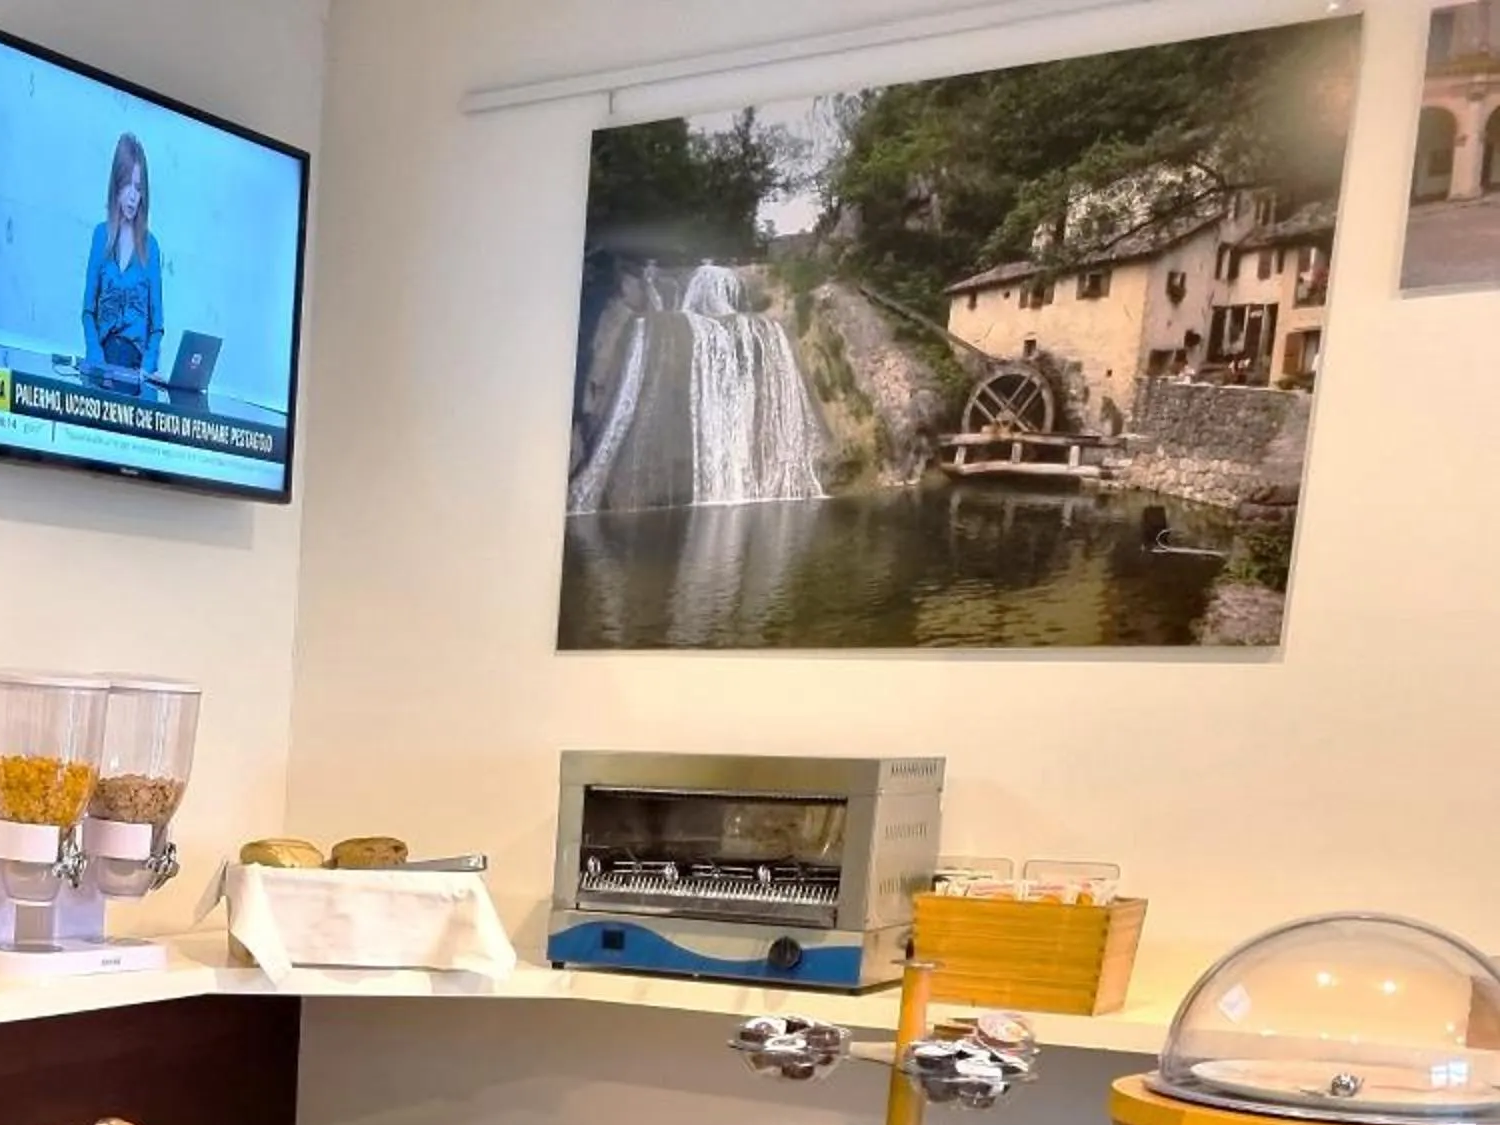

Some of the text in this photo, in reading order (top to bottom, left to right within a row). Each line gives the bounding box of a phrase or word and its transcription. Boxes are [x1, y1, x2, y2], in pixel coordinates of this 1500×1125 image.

[15, 384, 63, 415] PALERMO,
[65, 392, 100, 421] UCCISO
[136, 407, 153, 429] CHE
[155, 411, 181, 435] TENTA
[182, 417, 191, 437] DI
[191, 419, 229, 445] FERMARE
